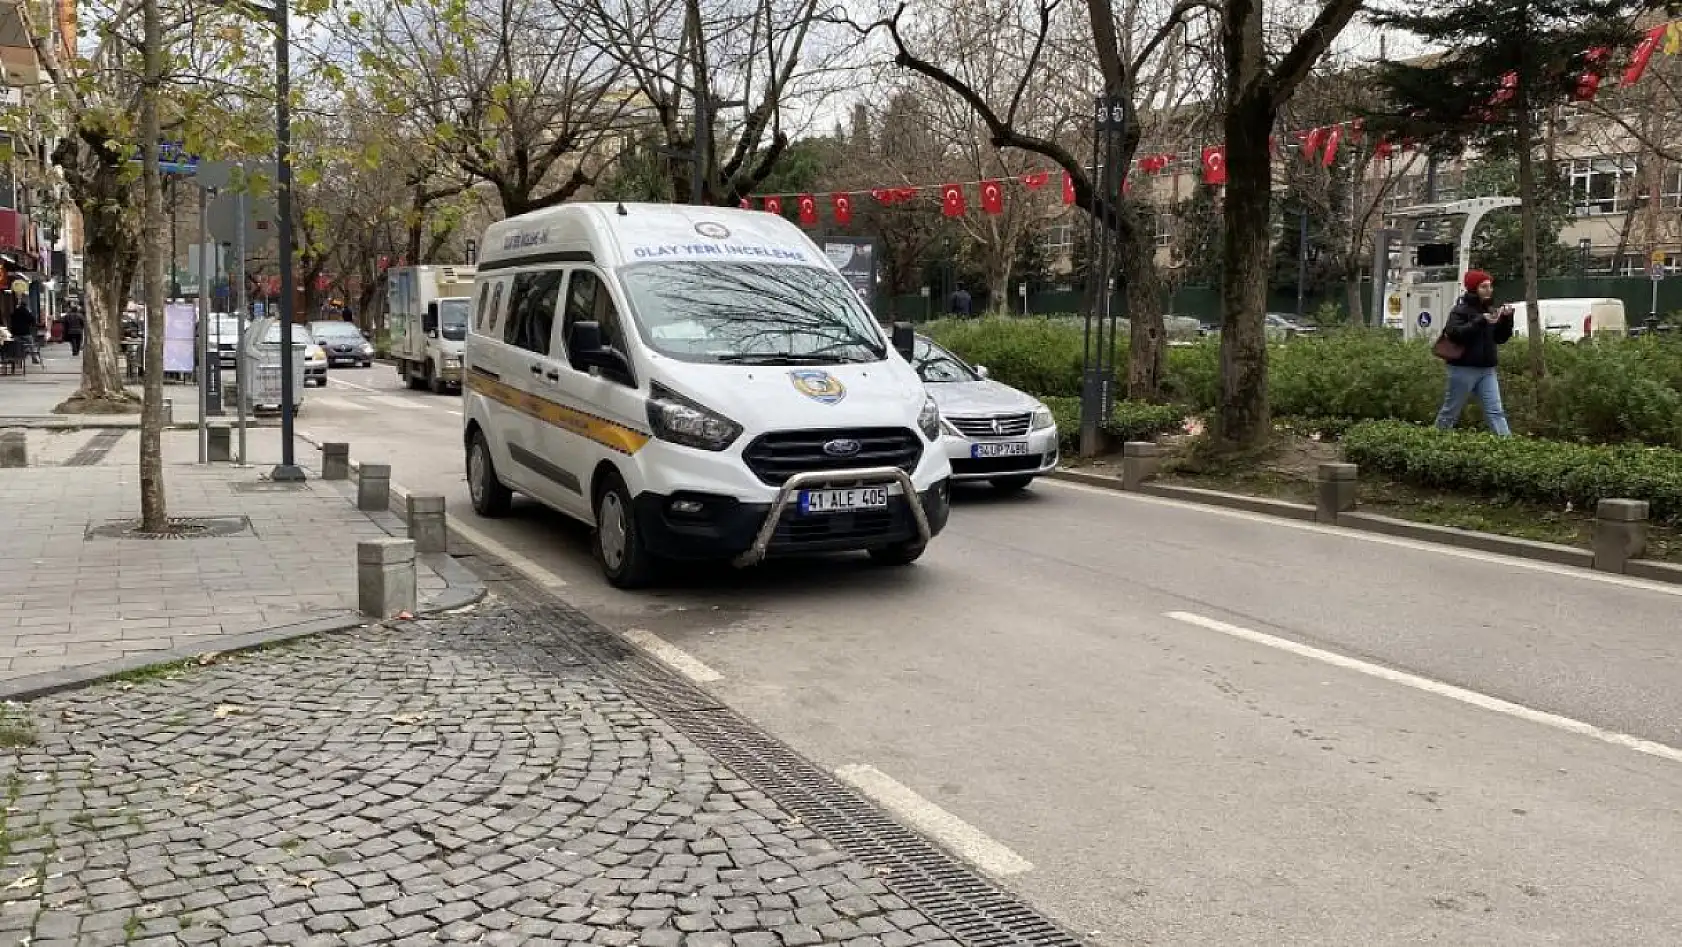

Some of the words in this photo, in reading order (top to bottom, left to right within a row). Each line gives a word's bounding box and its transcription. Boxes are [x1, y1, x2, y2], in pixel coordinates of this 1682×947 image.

[634, 245, 679, 258] OLAY
[724, 243, 807, 262] İNCELEME
[810, 493, 824, 509] 41
[831, 491, 856, 508] ALE
[863, 488, 887, 506] 405
